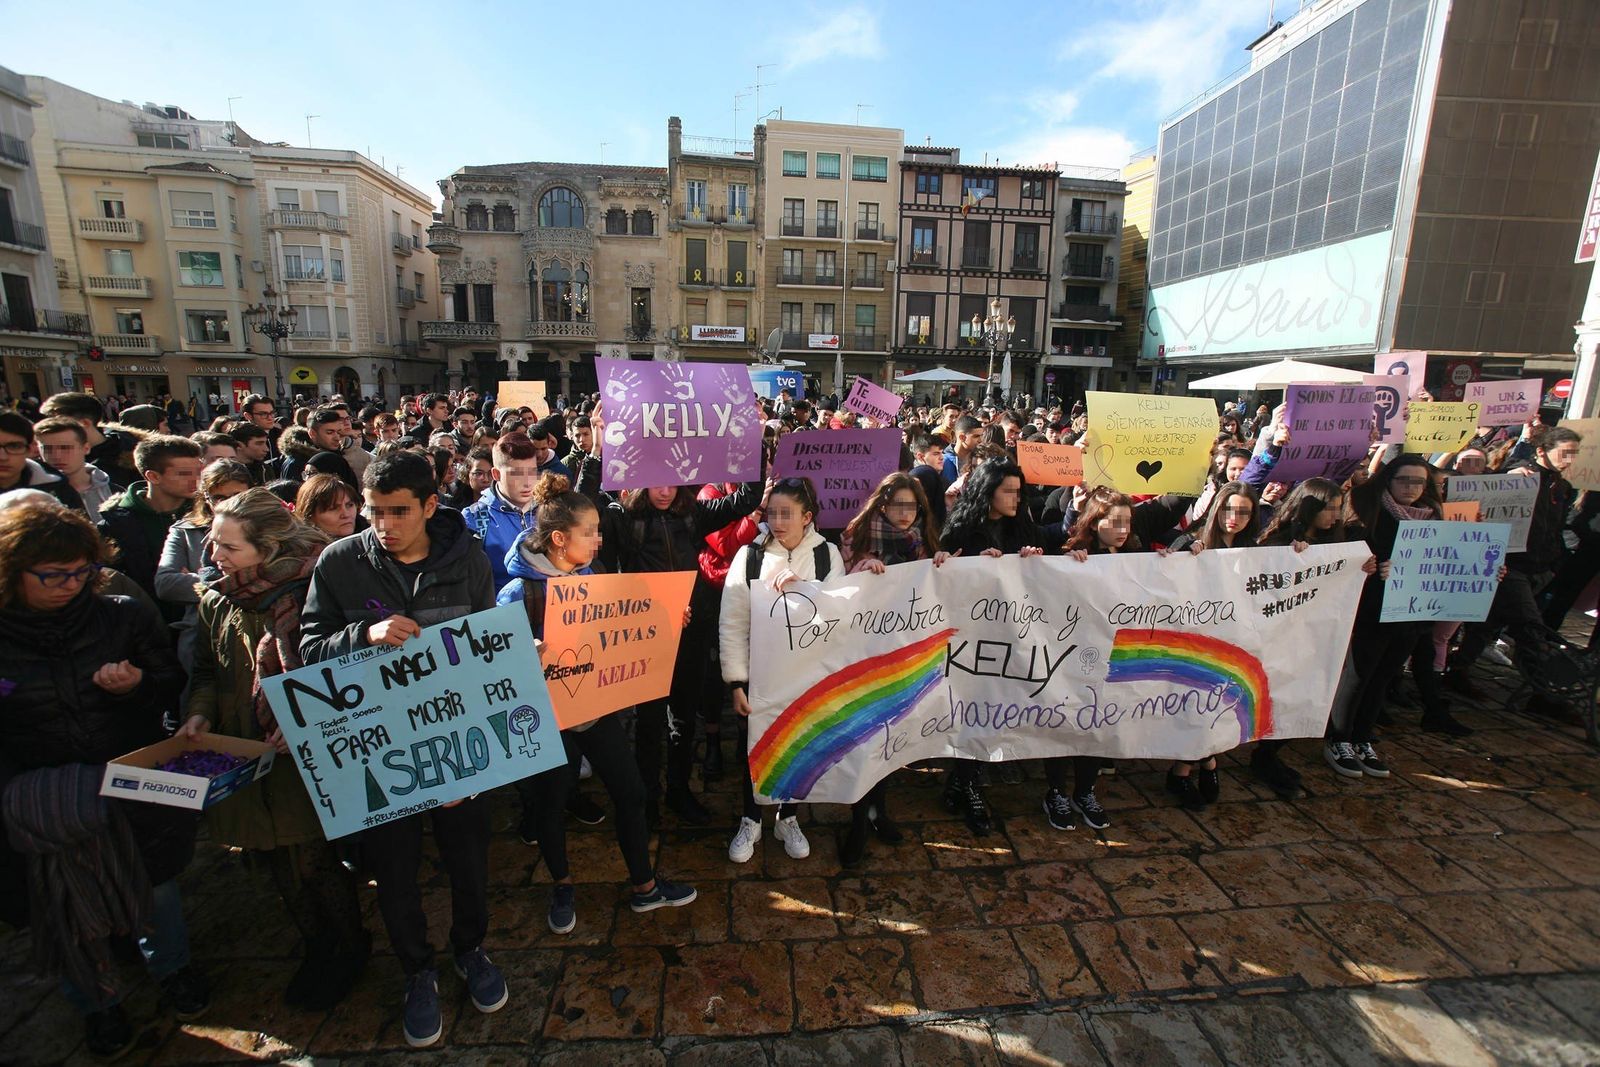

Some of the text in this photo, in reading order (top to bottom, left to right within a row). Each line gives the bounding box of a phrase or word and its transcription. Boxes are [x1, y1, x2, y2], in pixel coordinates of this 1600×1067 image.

[776, 375, 796, 388] tve
[1295, 389, 1335, 404] SOMOS
[1473, 385, 1486, 397] NI
[1137, 399, 1170, 411] KELLY
[1486, 403, 1529, 414] MENYS
[641, 402, 733, 439] KELLY
[1106, 408, 1214, 430] SIEMPRE ESTARÁS
[1294, 419, 1309, 431] DE
[1314, 419, 1335, 431] LAS
[1115, 432, 1197, 445] EN NUESTROS
[792, 442, 873, 456] DISCULPEN
[1020, 443, 1045, 454] TODAS
[1281, 446, 1302, 460] NO
[794, 459, 823, 471] LAS
[1043, 455, 1071, 464] SOMOS
[824, 478, 871, 490] ESTAN
[1456, 480, 1480, 492] HOY
[1481, 480, 1499, 492] NO
[1458, 531, 1491, 543] AMA
[1400, 545, 1460, 560] NO MATA
[1393, 561, 1480, 577] NI HUMILLA
[551, 581, 589, 606] NOS
[1390, 579, 1494, 594] NI MALTRATA
[562, 598, 652, 626] QUEREMOS
[770, 588, 1237, 650] Por nuestra amiga y compañera
[598, 624, 657, 652] VIVAS
[338, 654, 350, 666] NI
[352, 650, 374, 661] UNA
[379, 645, 438, 690] NACÍ
[440, 618, 514, 667] Mujer
[597, 657, 652, 688] KELLY
[944, 639, 1078, 698] KELLY
[326, 678, 518, 769] PARA MORIR POR
[879, 722, 908, 761] te
[921, 685, 1067, 737] echaremos
[1076, 685, 1128, 731] de
[296, 739, 336, 818] KELLY
[142, 781, 198, 799] DISCOVERY
